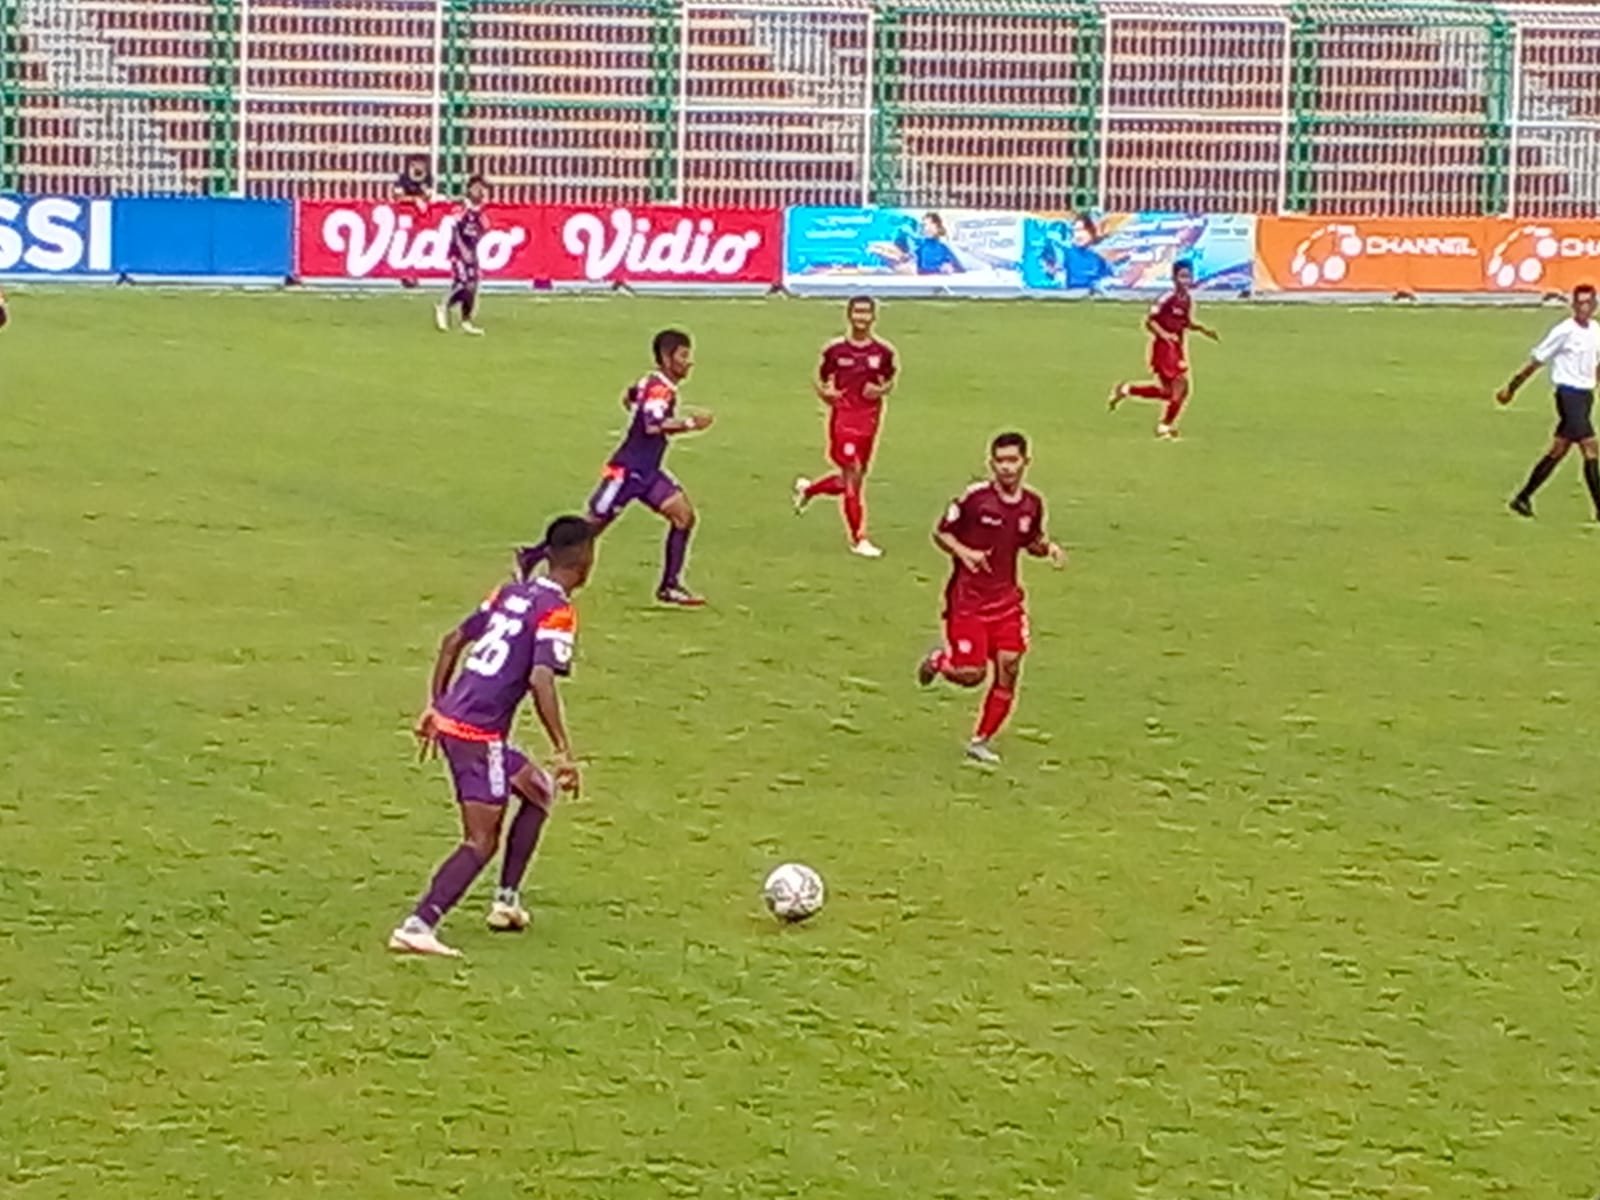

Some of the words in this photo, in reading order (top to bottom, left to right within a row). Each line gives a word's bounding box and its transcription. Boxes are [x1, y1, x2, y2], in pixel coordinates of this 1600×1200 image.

[322, 205, 525, 277] Vido
[562, 208, 761, 279] Vidio
[465, 611, 523, 676] 26
